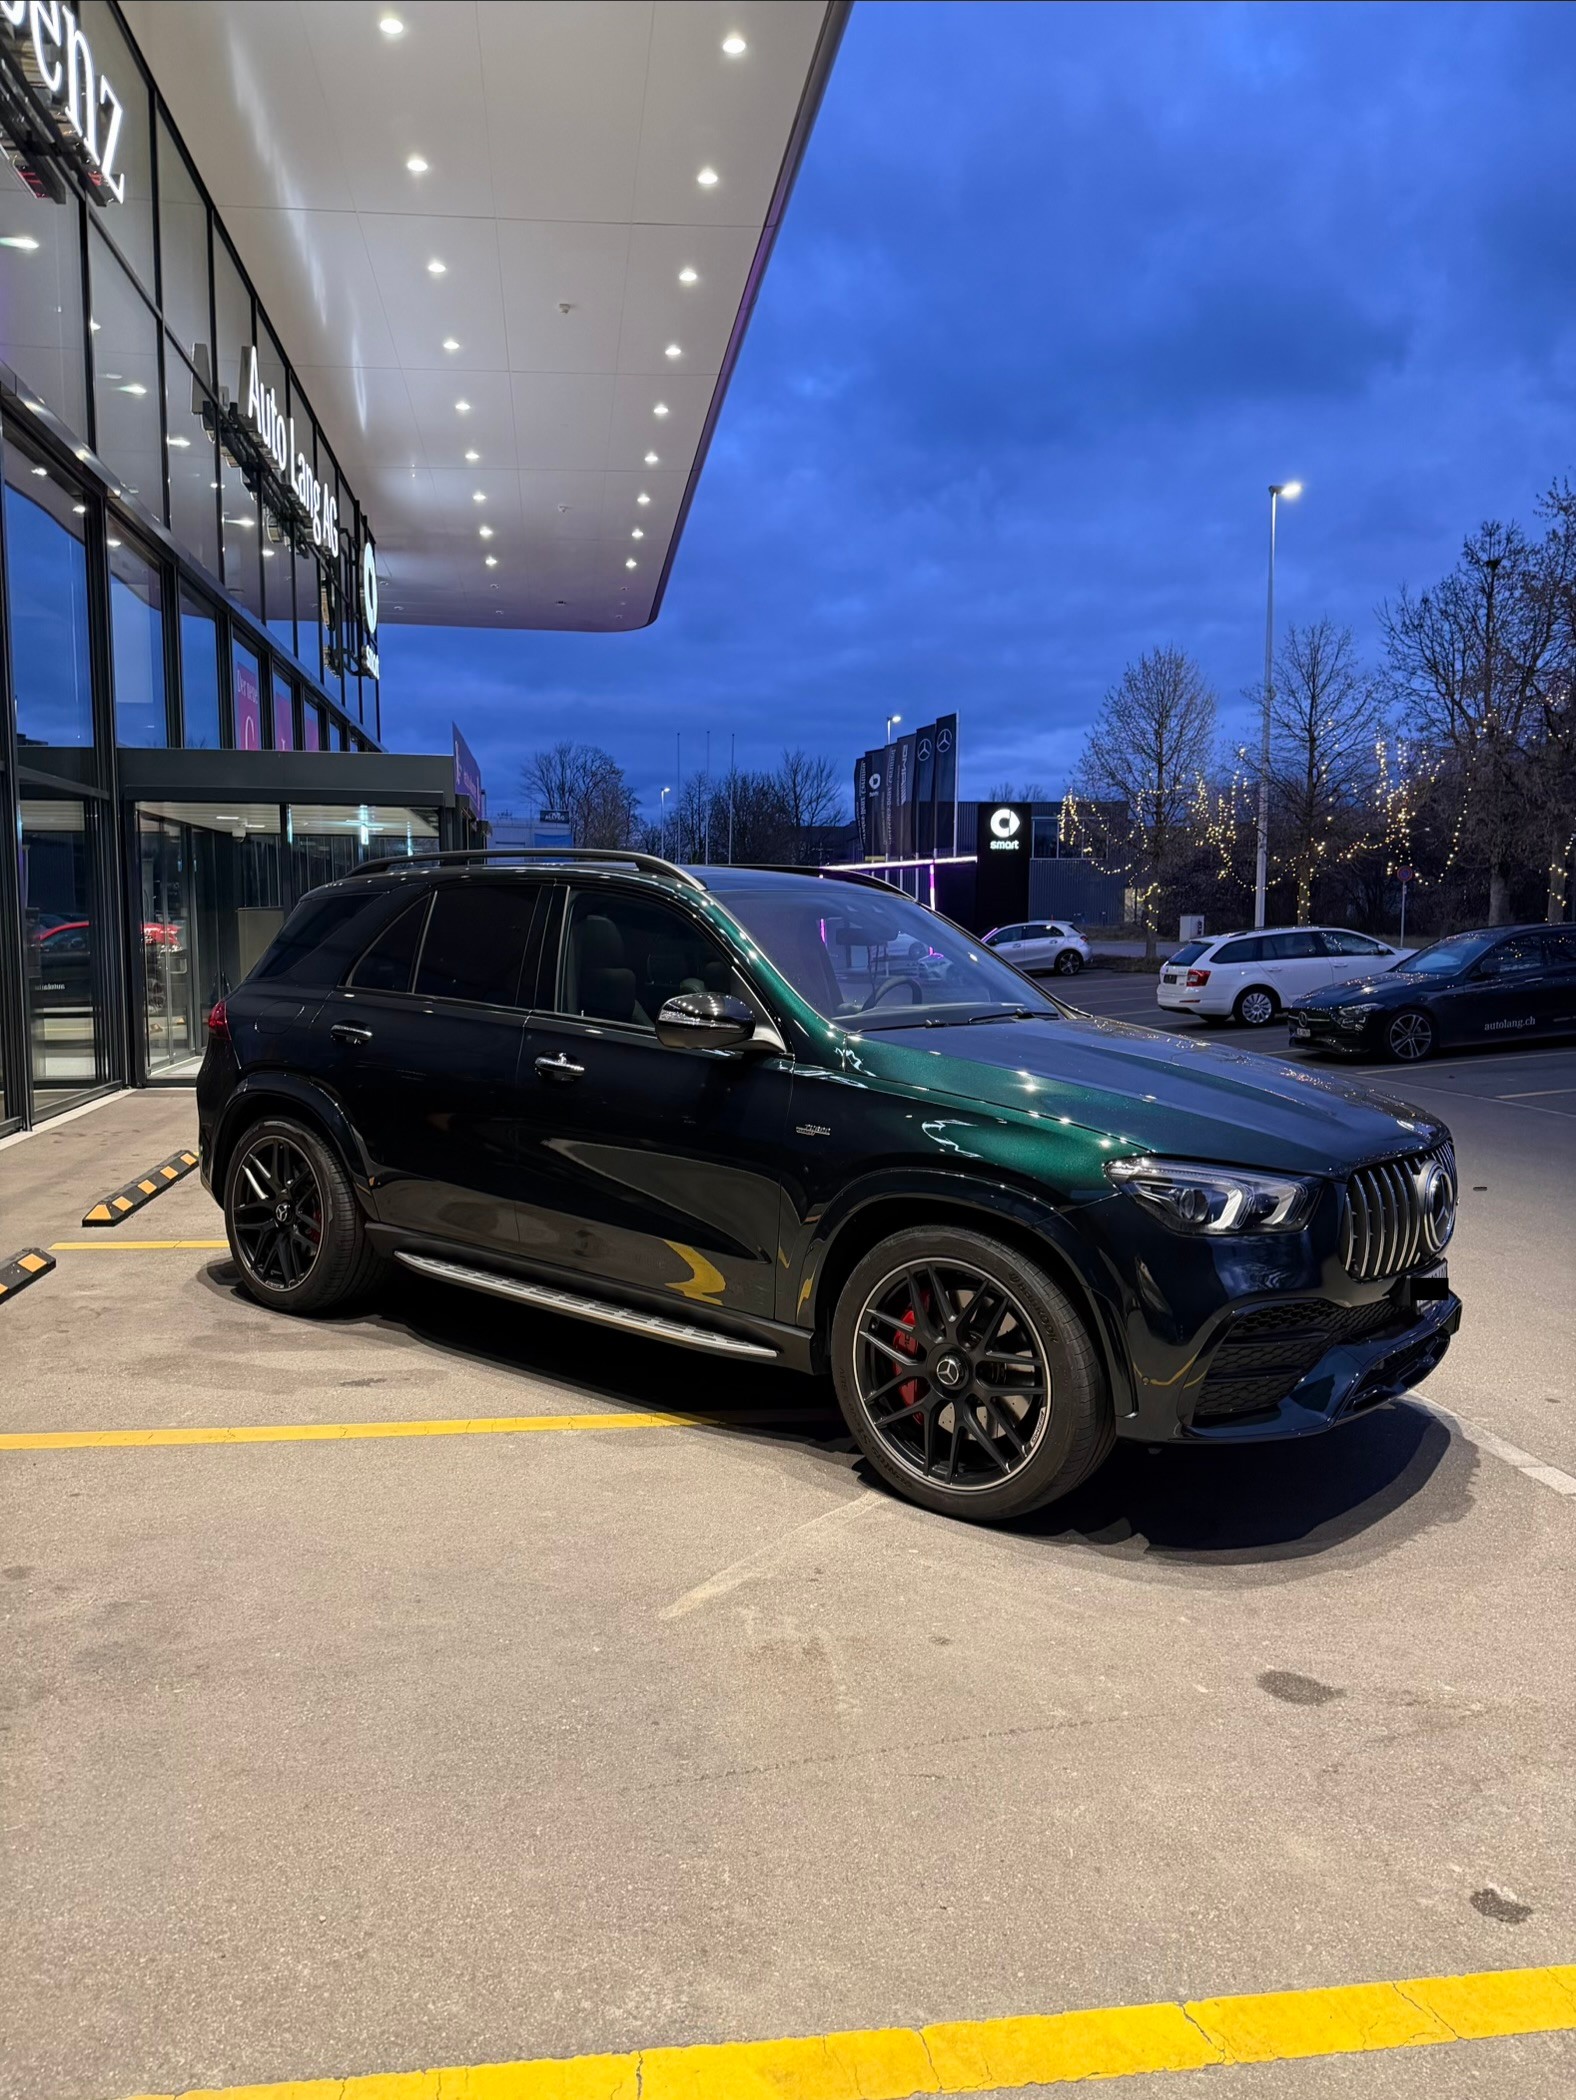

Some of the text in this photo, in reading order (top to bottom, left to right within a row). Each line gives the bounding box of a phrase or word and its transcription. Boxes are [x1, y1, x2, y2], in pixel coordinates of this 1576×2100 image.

[0, 0, 124, 204] enz
[248, 345, 339, 558] Auto Lang AG
[990, 839, 1020, 850] smart
[1484, 1016, 1535, 1030] autolang.ch
